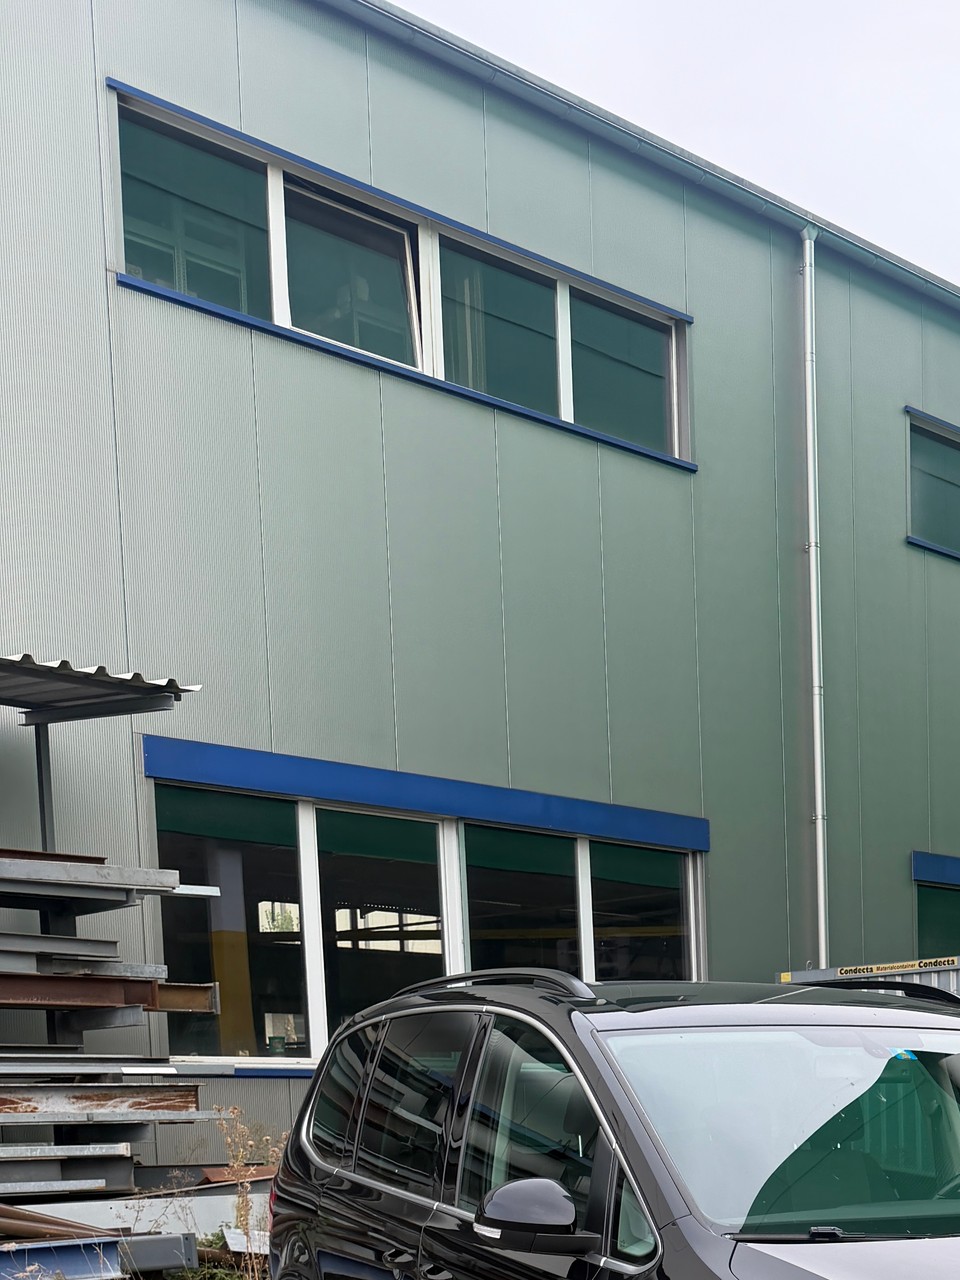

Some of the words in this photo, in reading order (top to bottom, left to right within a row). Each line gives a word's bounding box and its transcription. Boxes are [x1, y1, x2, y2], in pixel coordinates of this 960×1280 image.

[839, 965, 873, 975] Condecta
[876, 963, 916, 972] Materialcontainer
[918, 958, 955, 968] Condecta
